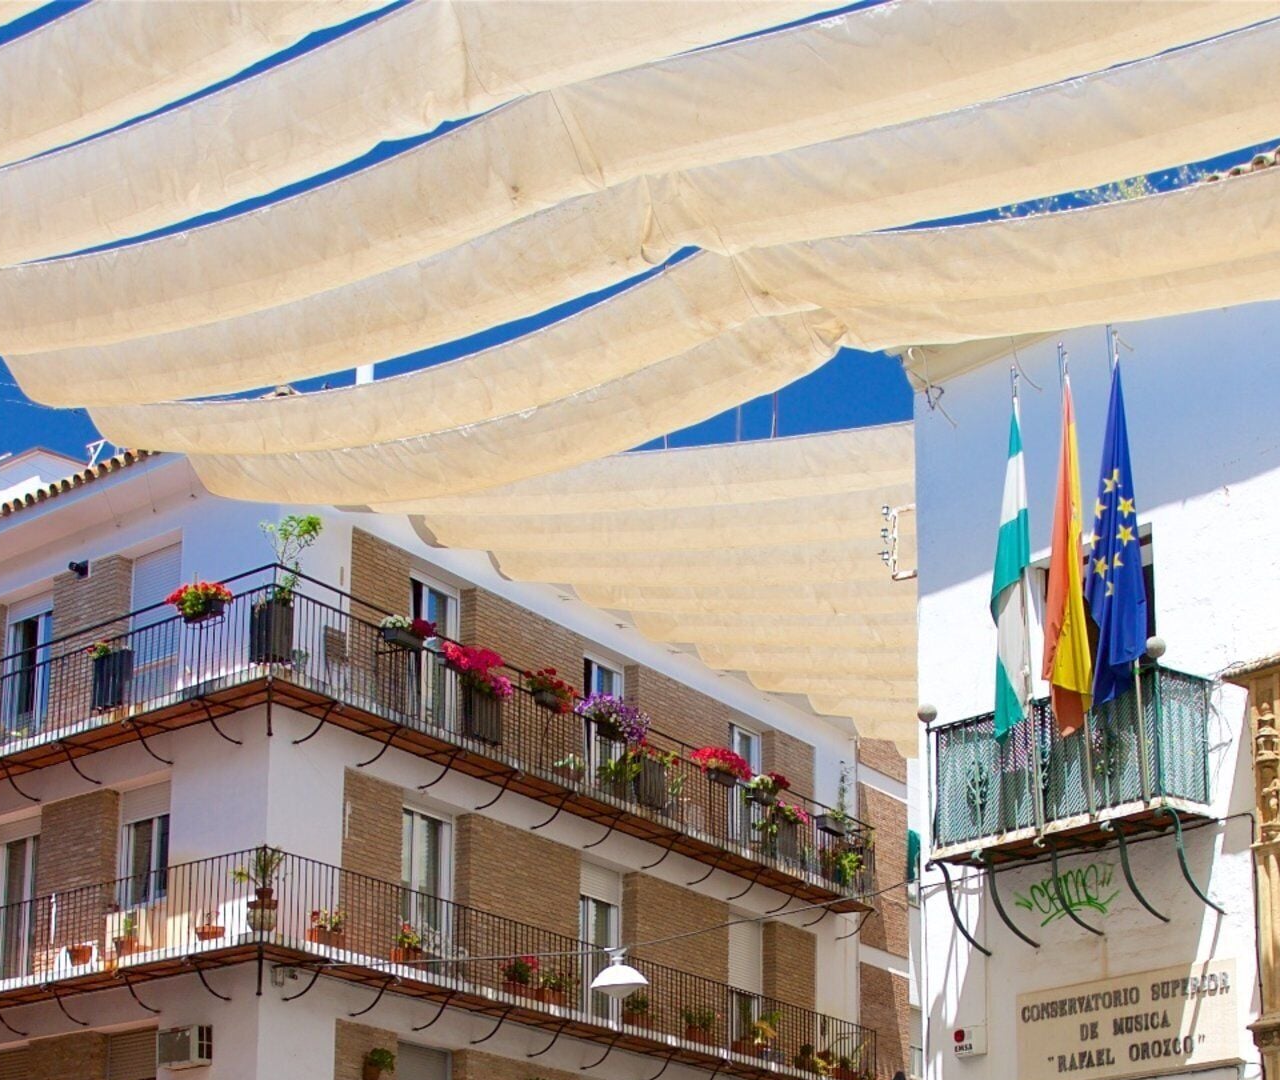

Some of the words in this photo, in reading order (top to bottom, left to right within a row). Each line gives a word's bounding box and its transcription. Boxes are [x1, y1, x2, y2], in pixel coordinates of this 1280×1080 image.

[1021, 986, 1141, 1023] CONSERVATORIO
[1150, 972, 1231, 1001] SUPERIOR
[1079, 1021, 1099, 1042] DE
[1112, 1010, 1171, 1036] MUSICA
